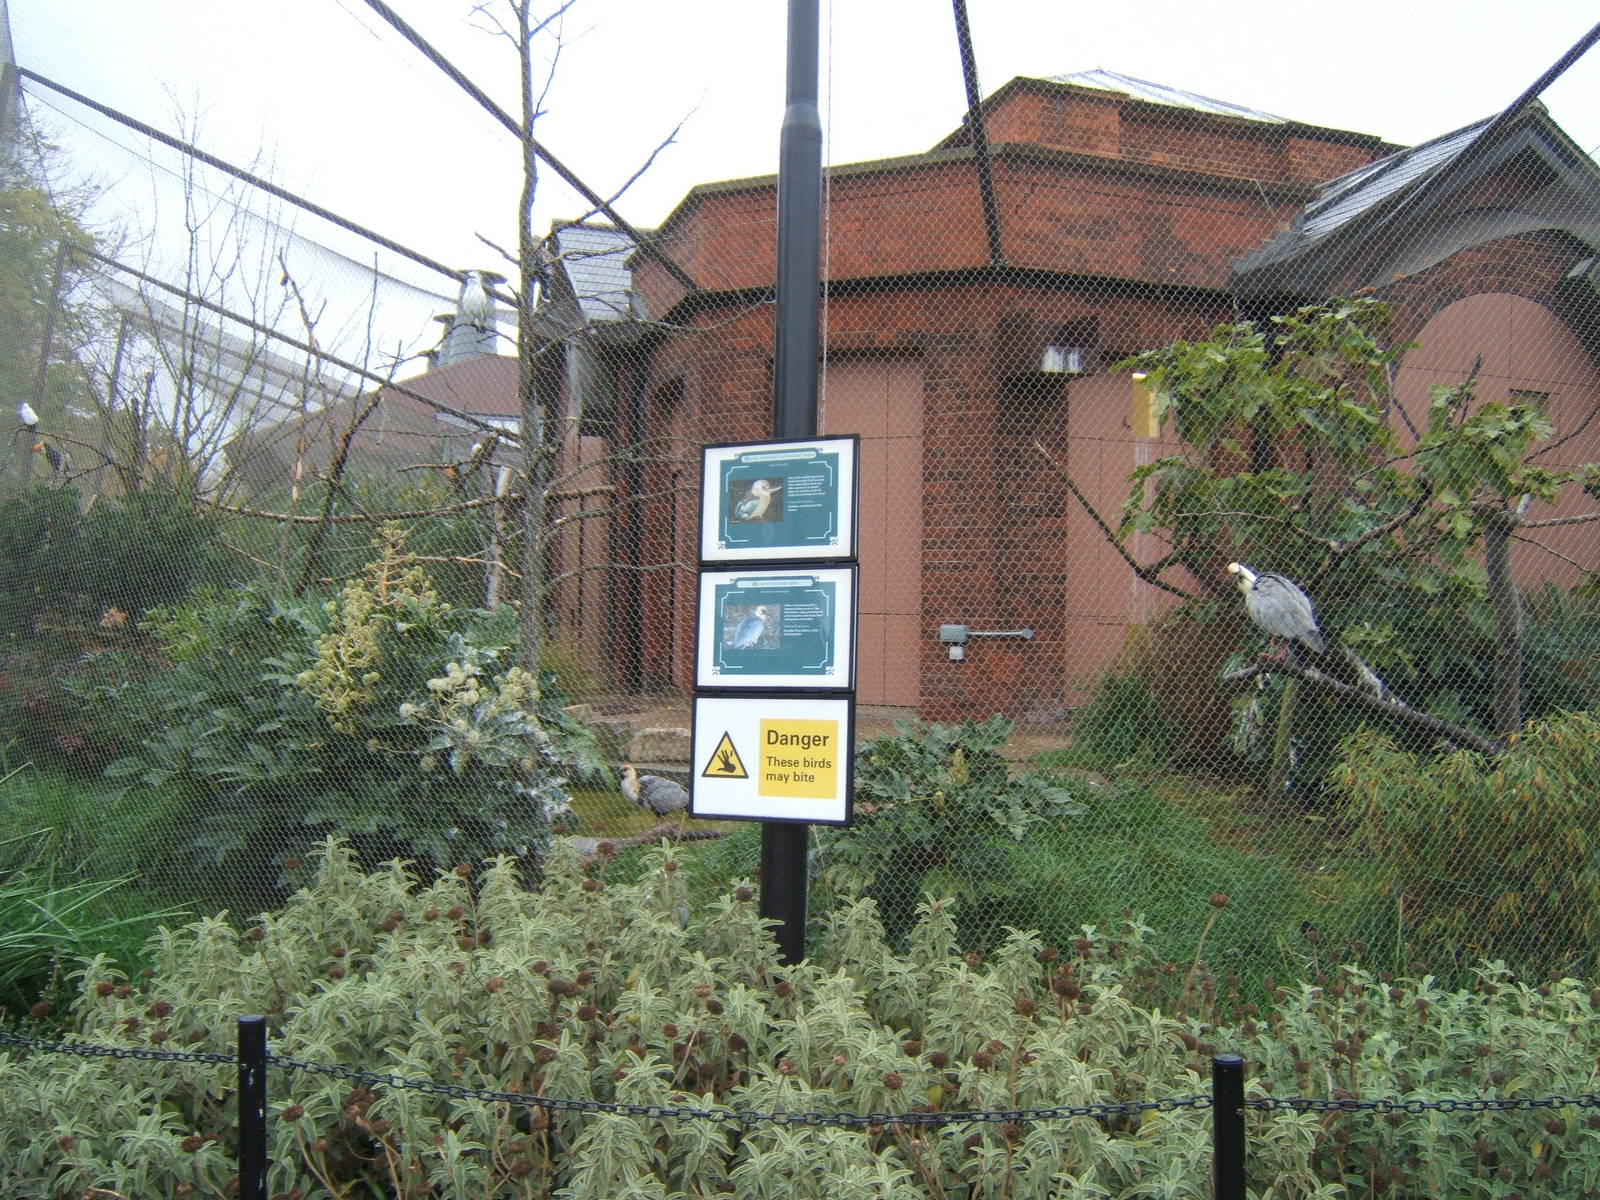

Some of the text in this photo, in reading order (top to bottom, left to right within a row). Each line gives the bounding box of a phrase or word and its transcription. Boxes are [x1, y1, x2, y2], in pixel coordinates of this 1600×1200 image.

[767, 729, 829, 750] Danger
[766, 756, 832, 769] These birds
[766, 771, 815, 784] may bite
